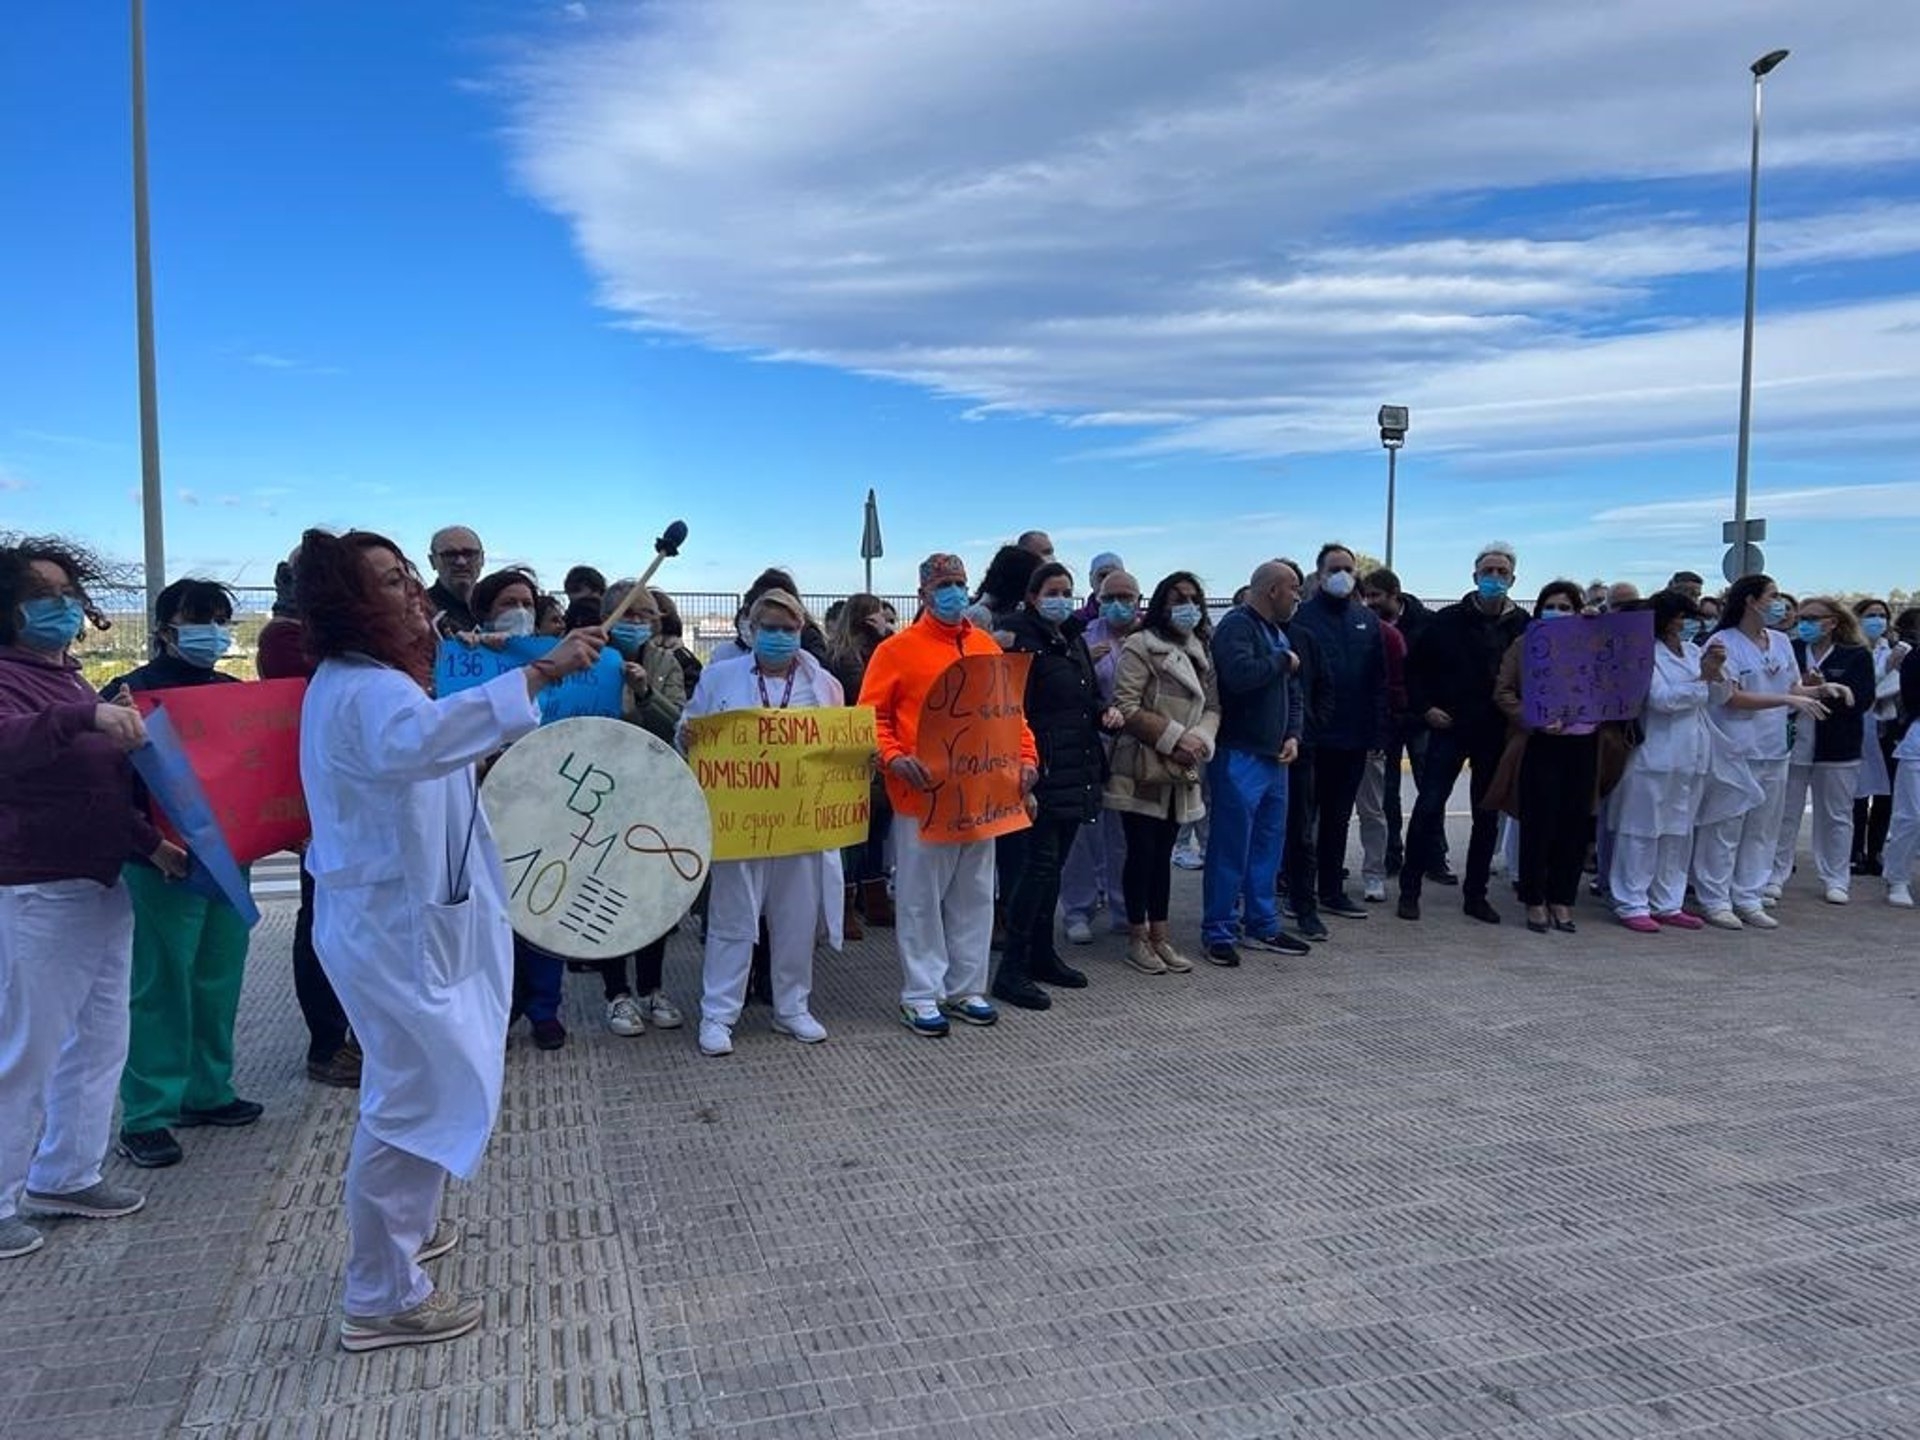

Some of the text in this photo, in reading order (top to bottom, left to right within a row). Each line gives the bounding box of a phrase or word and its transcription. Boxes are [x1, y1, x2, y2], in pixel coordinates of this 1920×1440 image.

[447, 652, 483, 678] 136
[758, 710, 821, 746] PÉSIMA
[698, 750, 780, 790] DIMISIÓN
